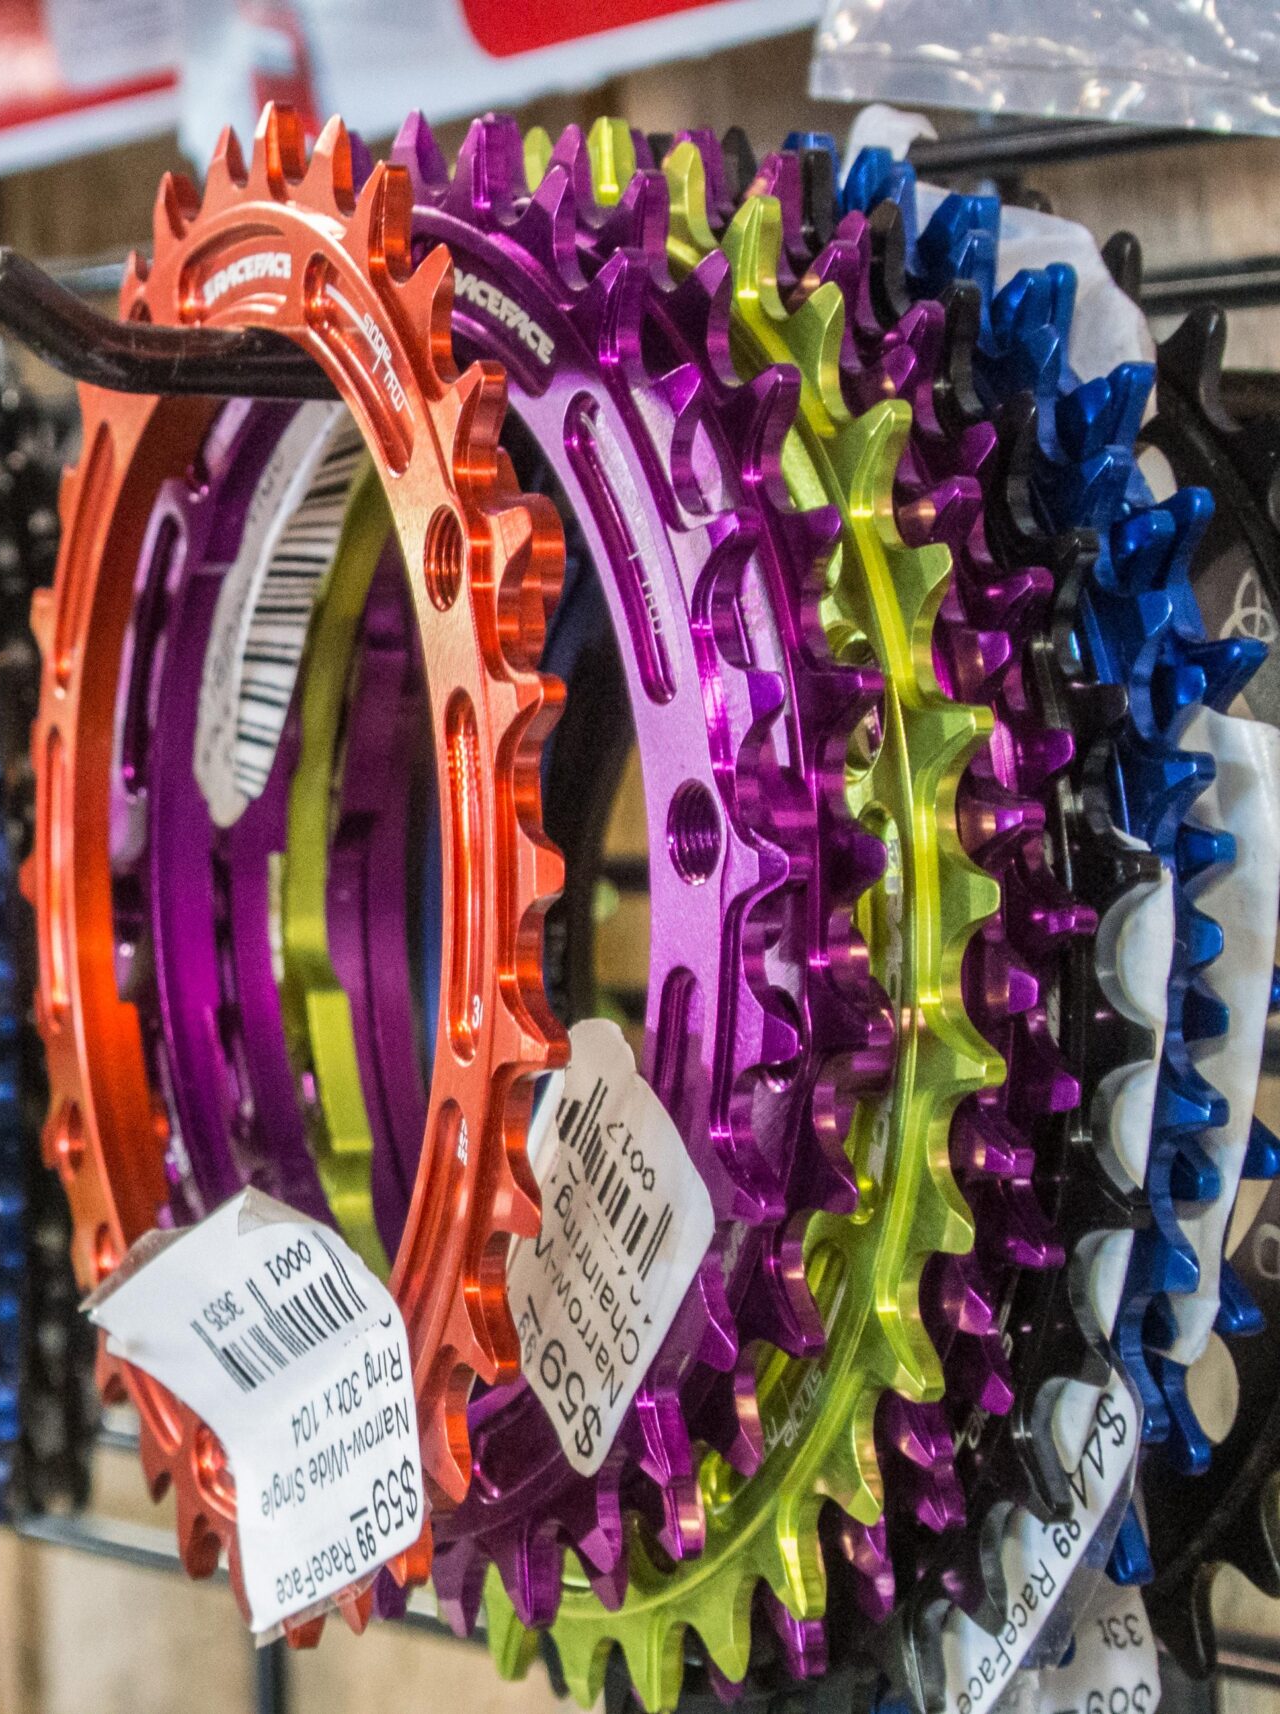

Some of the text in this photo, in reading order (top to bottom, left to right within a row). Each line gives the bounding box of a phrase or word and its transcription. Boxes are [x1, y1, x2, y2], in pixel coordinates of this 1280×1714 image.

[202, 251, 292, 308] RACEFACE
[264, 1237, 313, 1287] 0001
[292, 1342, 403, 1447] Ring 30t x 104
[261, 1397, 410, 1521] Narrow-Wide Single
[276, 1535, 358, 1605] RaceFace
[956, 1559, 1057, 1714] RaceFace
